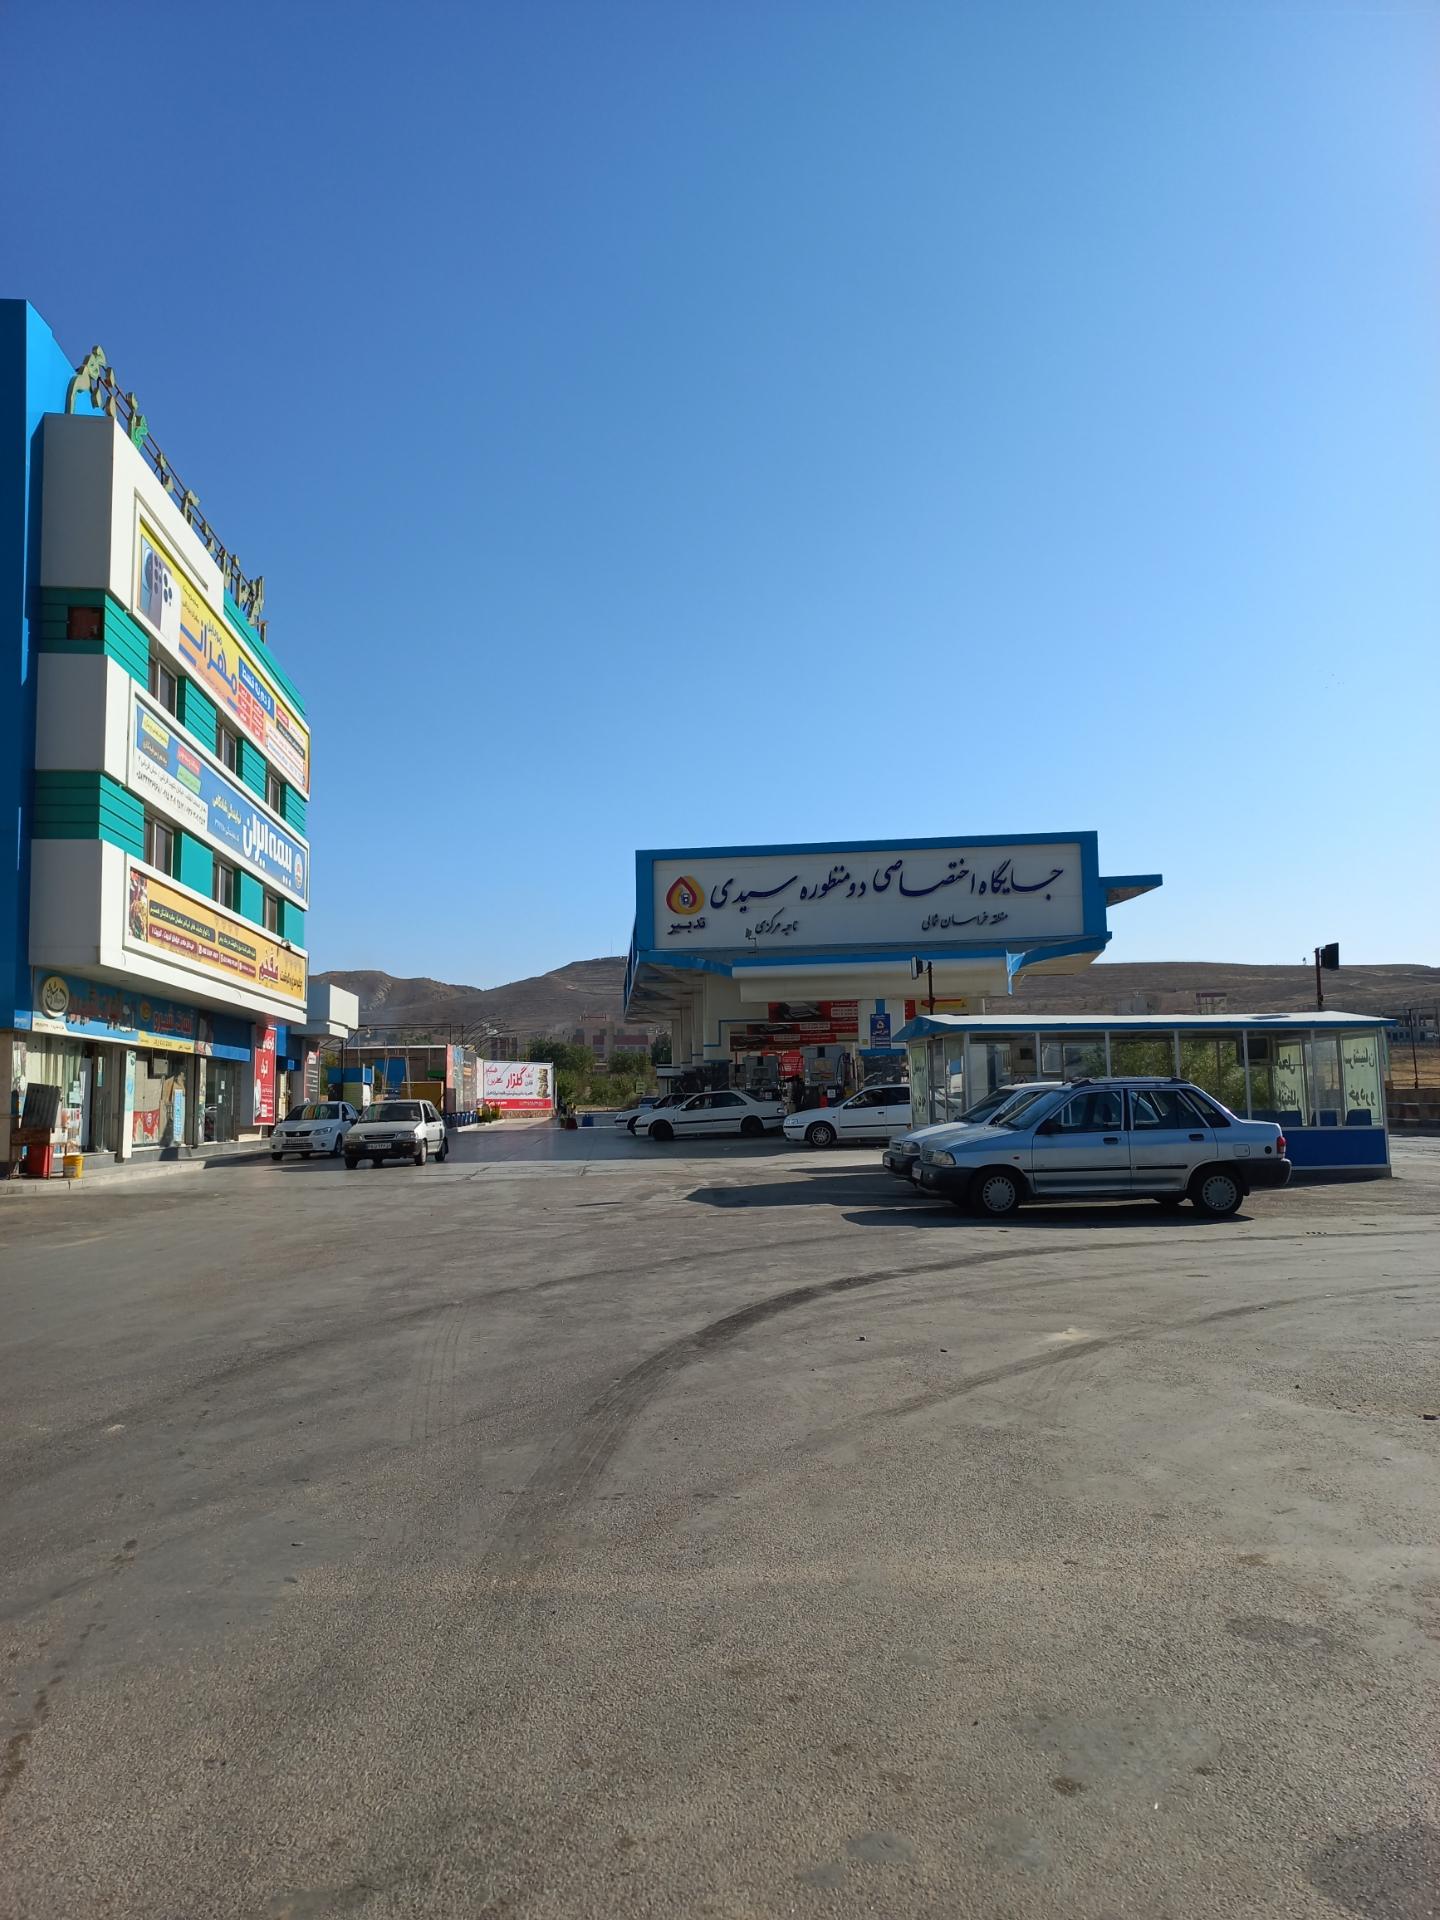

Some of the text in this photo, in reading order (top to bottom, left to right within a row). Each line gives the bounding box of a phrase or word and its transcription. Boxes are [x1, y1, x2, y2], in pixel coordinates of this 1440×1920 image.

[242, 813, 269, 869] ایران
[268, 831, 292, 888] بیمه
[709, 875, 798, 913] سیدی
[872, 858, 976, 898] اختصاصی
[978, 859, 1064, 901] جایگاه
[667, 917, 707, 935] تدبیر
[754, 907, 799, 937] ناحیه مرکزی
[921, 912, 1009, 931] منطقه خراسان شمالی
[505, 1065, 528, 1089] گلزار
